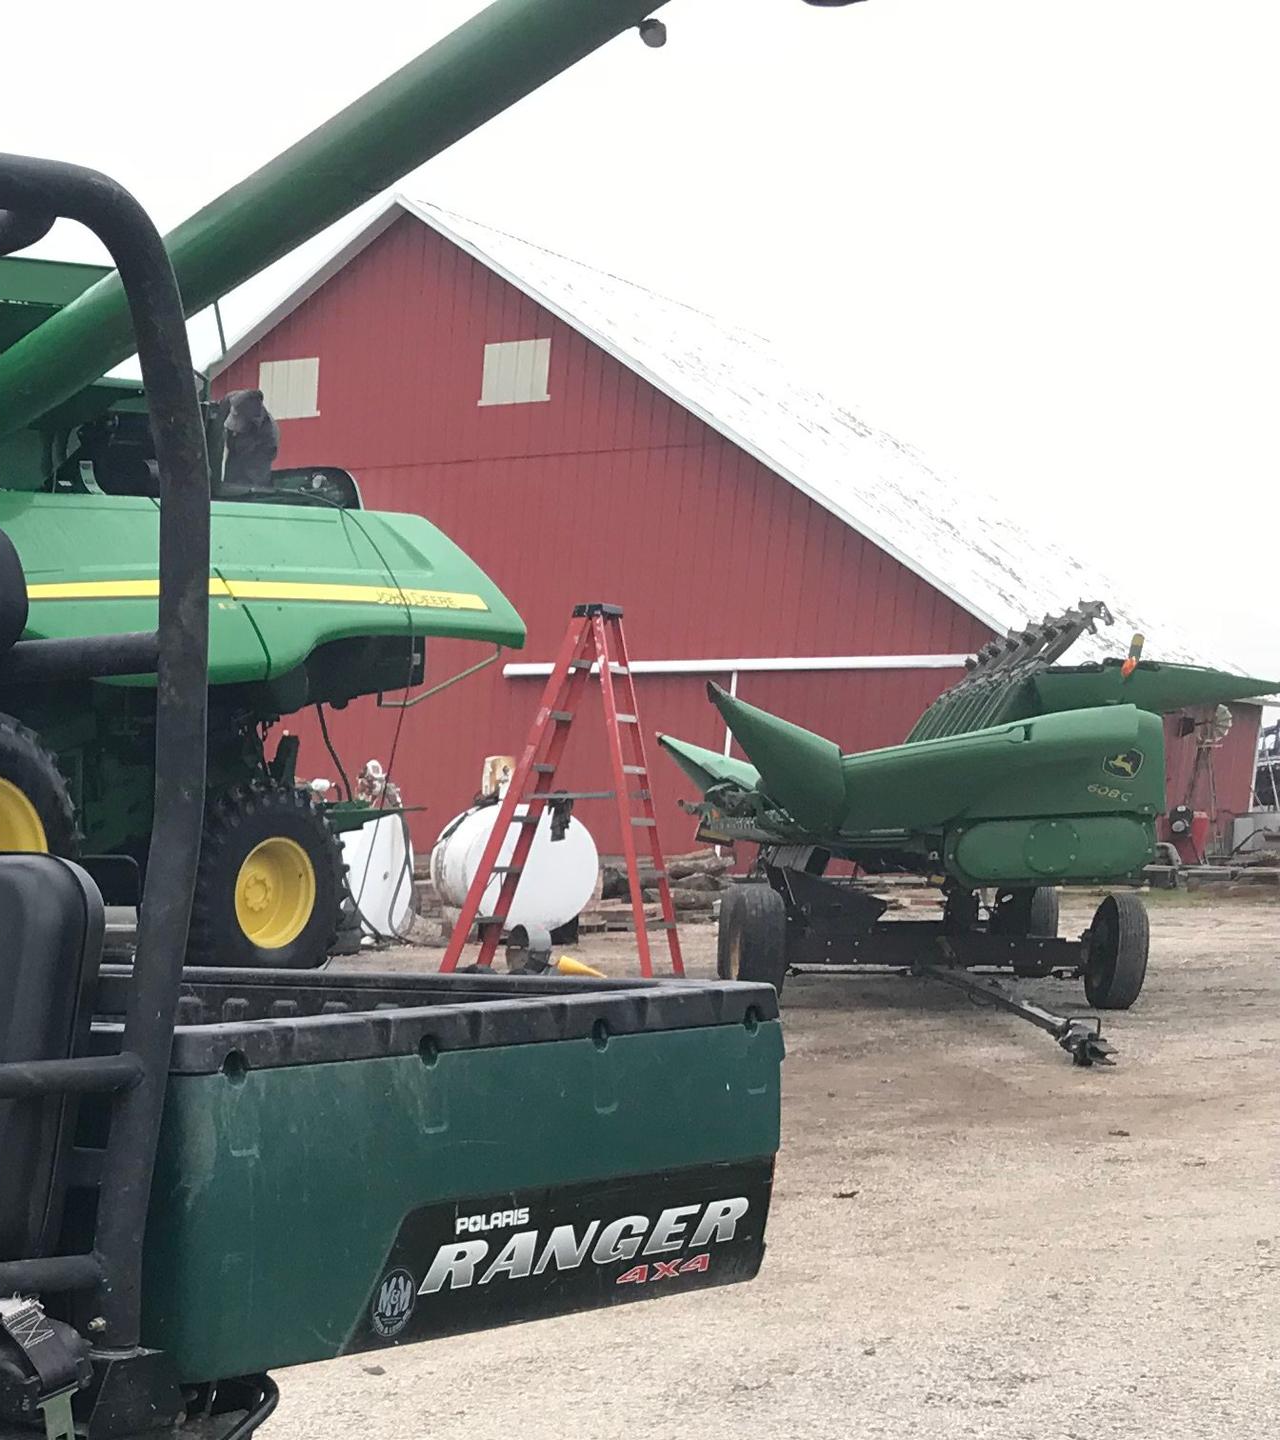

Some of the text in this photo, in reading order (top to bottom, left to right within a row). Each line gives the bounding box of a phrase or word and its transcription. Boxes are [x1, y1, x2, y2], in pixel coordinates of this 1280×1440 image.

[1087, 783, 1133, 802] 608C
[455, 1207, 531, 1235] POLARIS
[416, 1196, 749, 1296] RANGER
